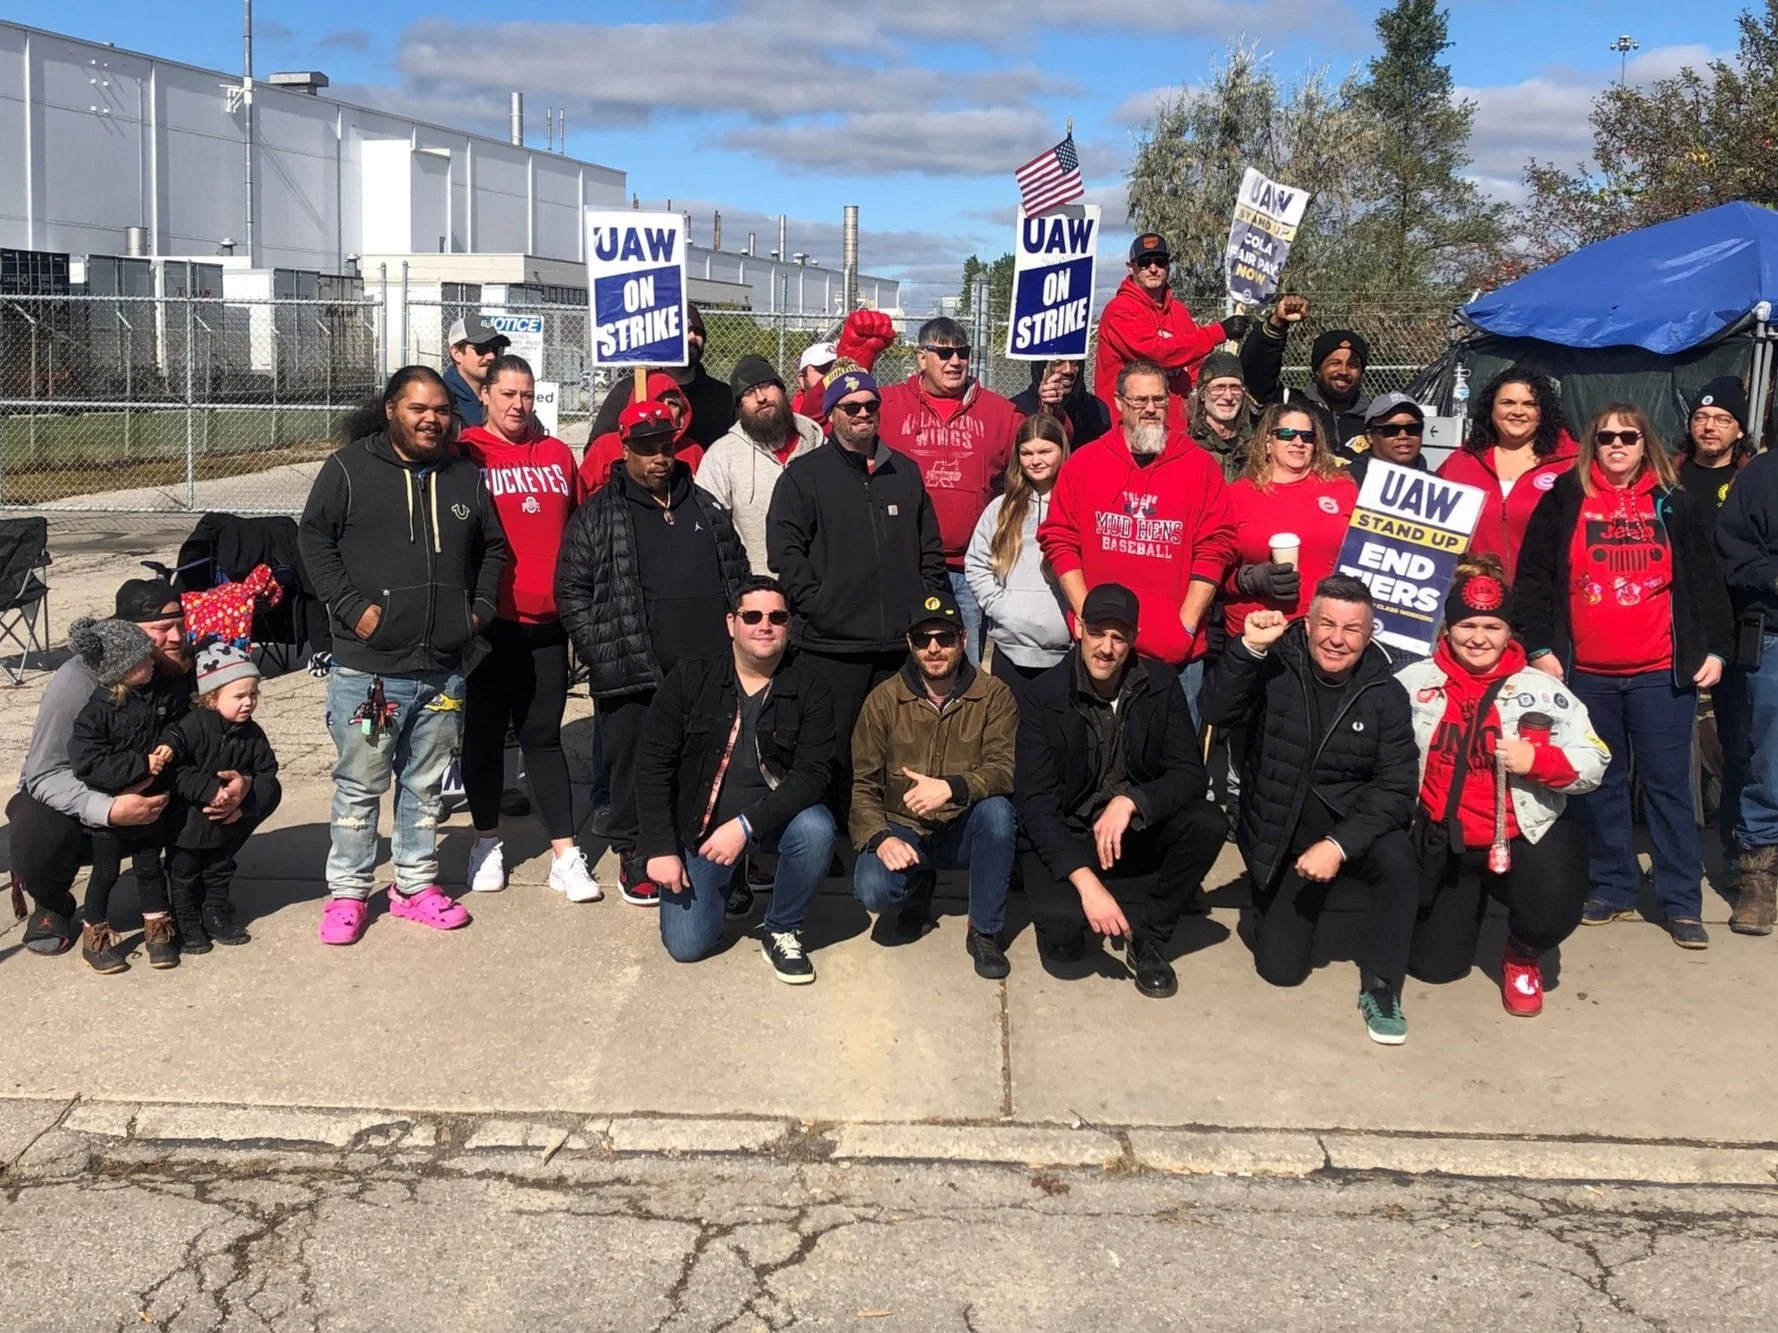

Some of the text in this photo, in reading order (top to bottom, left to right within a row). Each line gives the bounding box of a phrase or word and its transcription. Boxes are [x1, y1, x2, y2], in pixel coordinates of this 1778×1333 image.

[1249, 178, 1295, 215] UAW
[1023, 217, 1094, 254] UAW
[1239, 209, 1271, 235] STAND
[593, 226, 677, 263] UAW
[1230, 244, 1279, 277] FAIR PAY
[1244, 232, 1273, 256] COLA
[1042, 267, 1071, 307] ON
[1235, 263, 1265, 285] NOW
[623, 274, 655, 313] ON
[491, 317, 540, 332] OTICE
[597, 304, 680, 357] STRIKE
[1015, 297, 1088, 349] STRIKE
[536, 392, 554, 404] ed
[916, 428, 973, 449] WINGS
[1379, 469, 1465, 524] UAW
[1095, 510, 1183, 545] MUD HENS
[1357, 513, 1460, 549] STAND UP
[1102, 536, 1173, 560] BASEBALL
[1357, 541, 1436, 581] END
